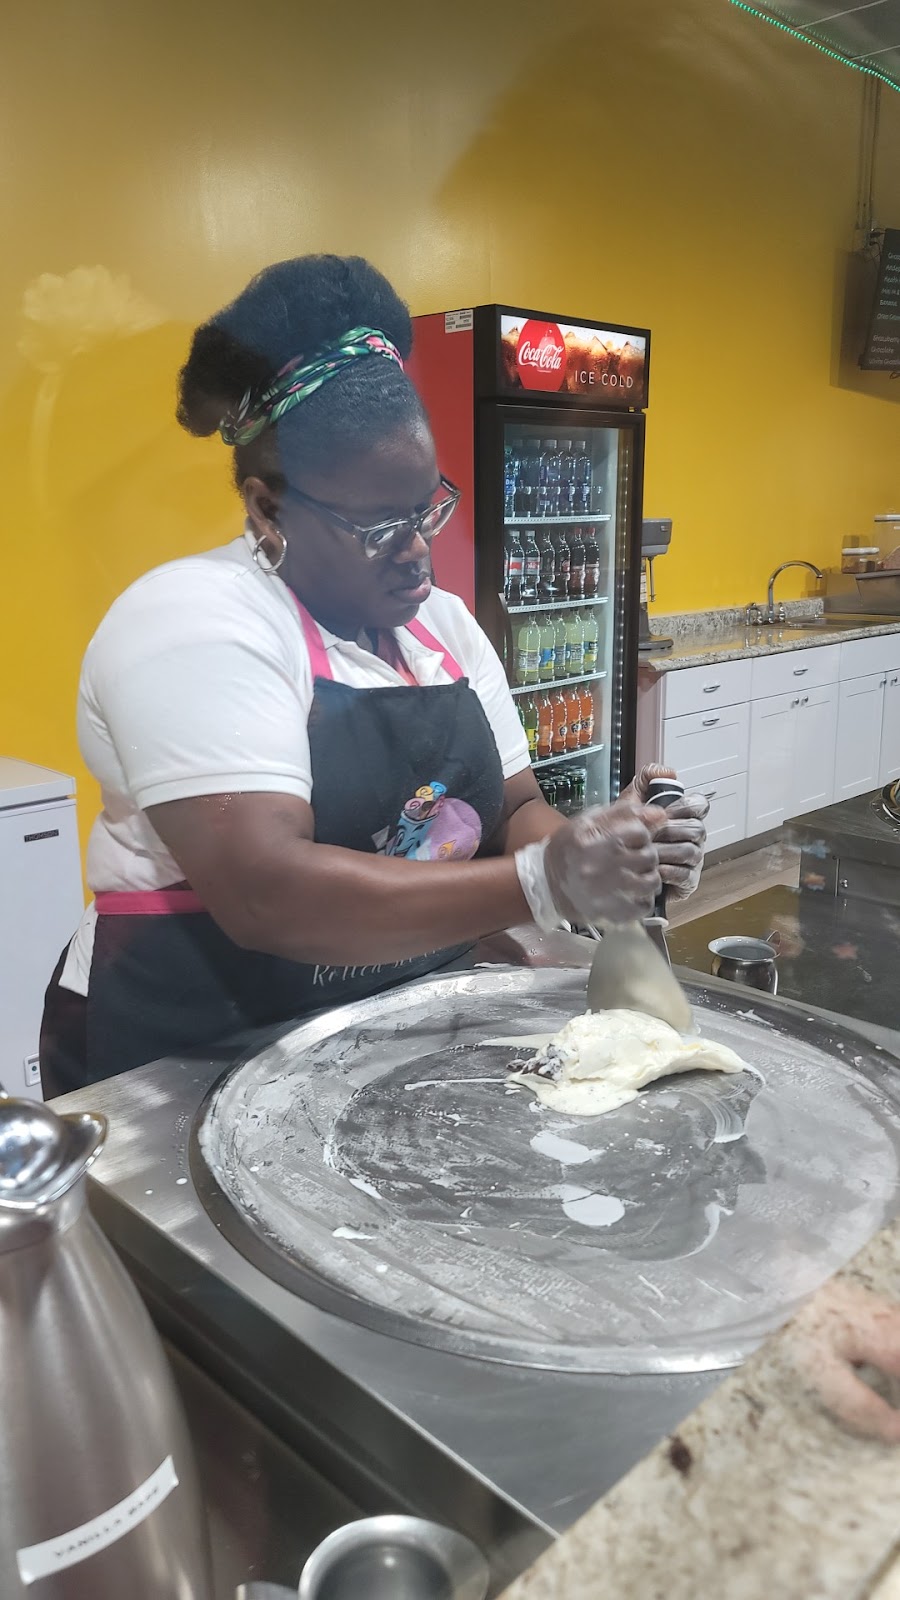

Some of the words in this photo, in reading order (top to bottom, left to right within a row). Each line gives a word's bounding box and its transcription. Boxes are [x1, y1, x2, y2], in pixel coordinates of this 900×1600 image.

[518, 340, 564, 370] Coca-Cola
[574, 370, 595, 385] ICE
[601, 374, 634, 389] COLD
